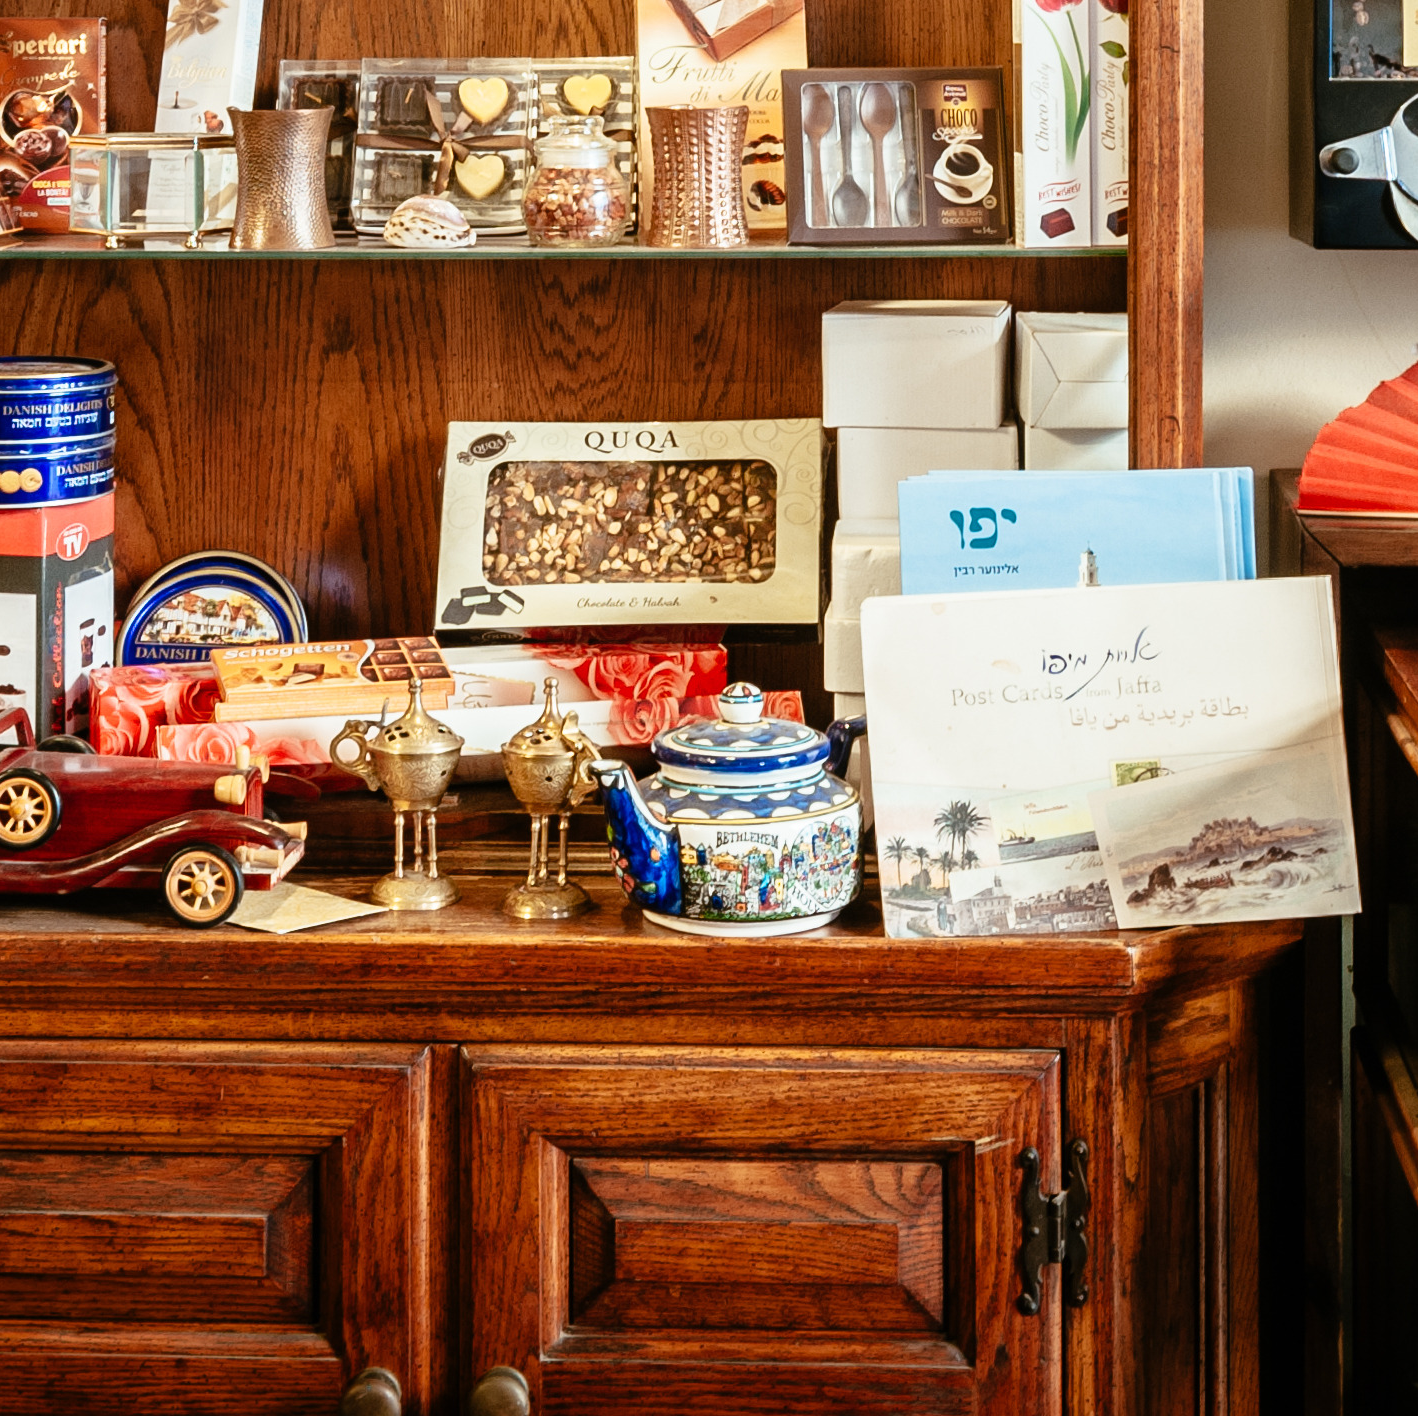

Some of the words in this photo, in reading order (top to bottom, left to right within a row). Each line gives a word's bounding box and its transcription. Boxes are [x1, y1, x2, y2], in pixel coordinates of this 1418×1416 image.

[649, 44, 737, 84] Frutti
[1095, 61, 1121, 102] Party
[690, 83, 711, 103] di
[940, 108, 978, 127] CHOCO
[1101, 102, 1116, 151] Choco
[932, 125, 978, 141] Spoons
[1034, 104, 1050, 152] Choco
[941, 217, 983, 225] CHOCOLATE
[2, 404, 49, 416] DANISH
[55, 399, 103, 415] DELIGHTS
[11, 417, 42, 429] חמאה
[473, 438, 505, 455] QUQA
[584, 430, 680, 453] QUQA
[56, 462, 95, 477] DANISH
[949, 507, 1017, 550] יפו
[63, 532, 83, 557] TV
[953, 565, 976, 578] רבין
[977, 563, 1020, 576] אלינוער
[576, 596, 626, 609] Chocolate
[629, 596, 639, 608] &
[641, 596, 680, 608] Halvah
[51, 581, 64, 688] Collection
[135, 646, 195, 661] DANISH
[224, 643, 350, 661] Schogetten
[951, 687, 995, 707] Post
[1001, 683, 1064, 703] Cards
[1085, 687, 1112, 698] from
[1115, 676, 1163, 698] Jaffa
[1068, 705, 1097, 728] يافا
[1137, 702, 1194, 728] بريدية
[1200, 697, 1249, 720] بطاقة
[1102, 709, 1131, 731] من
[716, 831, 779, 850] BETHLEHEM
